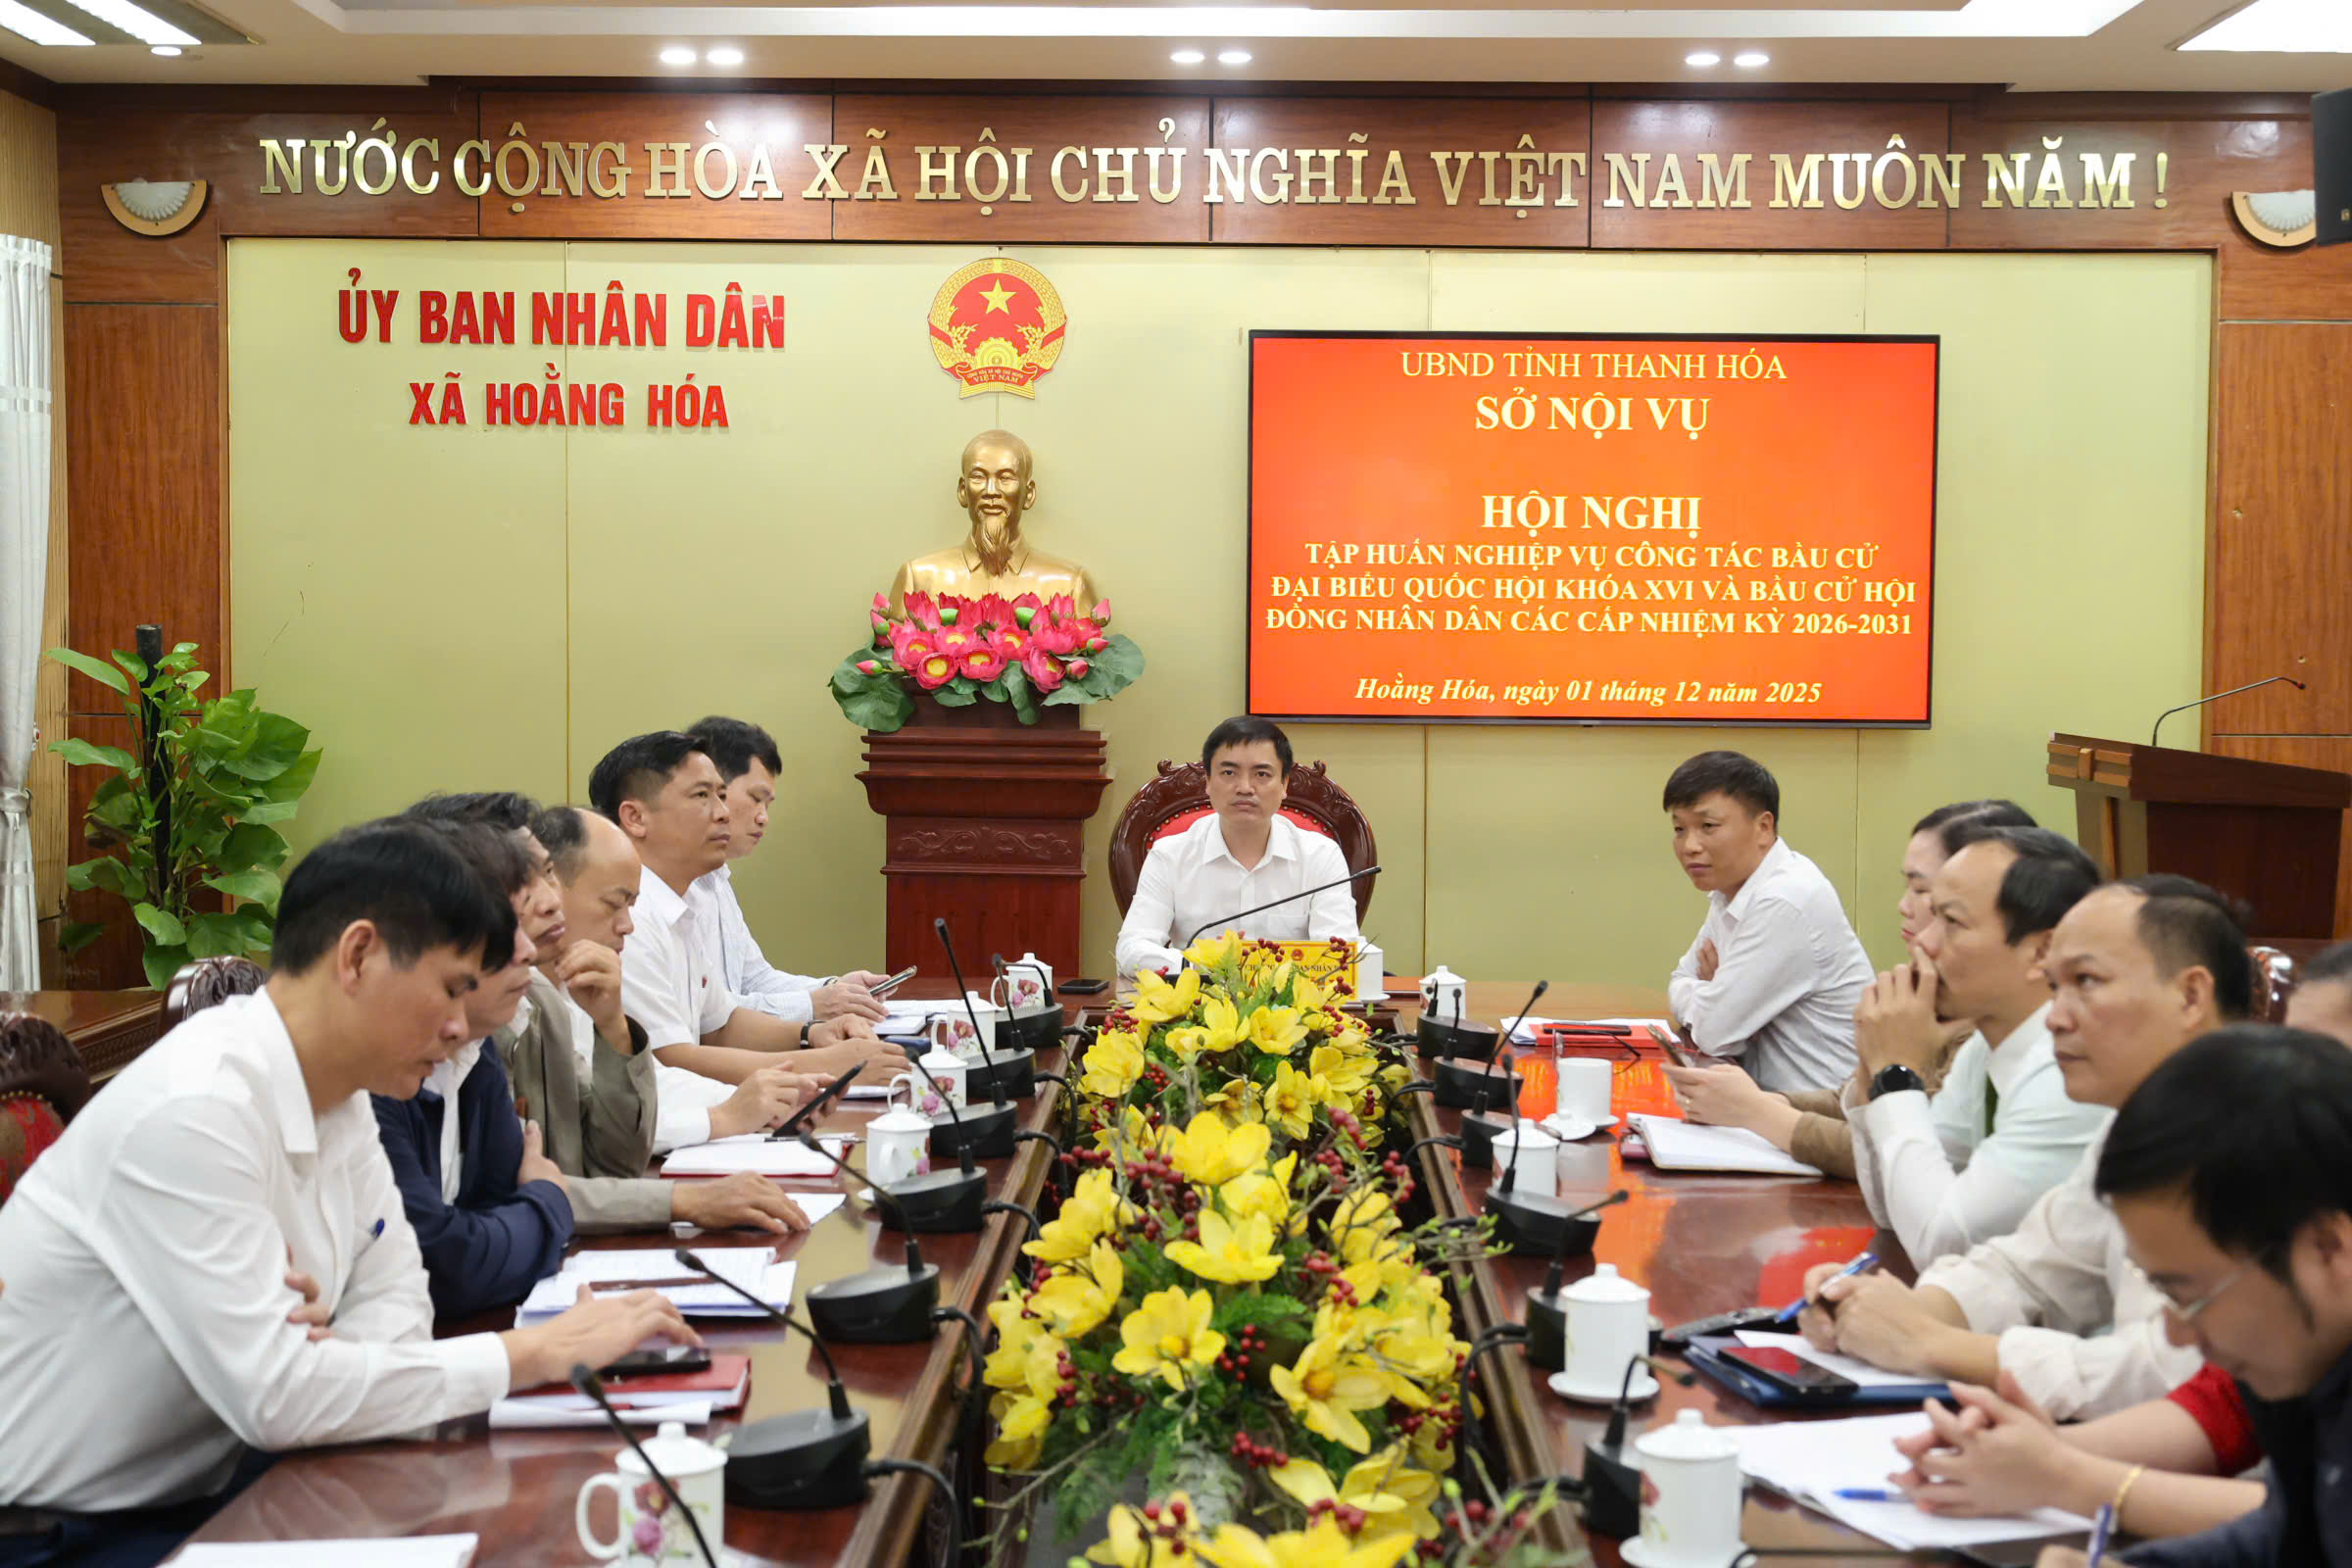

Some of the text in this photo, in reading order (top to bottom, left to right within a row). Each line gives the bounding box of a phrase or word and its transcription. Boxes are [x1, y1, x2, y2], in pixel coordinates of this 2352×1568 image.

[260, 118, 439, 195] NƯỚC
[454, 122, 632, 213] CỘNG
[644, 120, 784, 199] HÒA
[802, 127, 898, 199] XÃ
[914, 127, 1033, 216] HỘI
[1051, 118, 1187, 203] CHỦ
[1203, 132, 1416, 204] NGHĨA
[1431, 134, 1587, 219] VIỆT
[1603, 153, 1752, 209] NAM
[1769, 133, 1966, 210] MUÔN
[1982, 136, 2136, 209] NĂM
[338, 268, 785, 348] ỦY BAN NHÂN DÂN
[1401, 346, 1787, 379] UBND TỈNH THANH HÓA
[410, 363, 728, 426] XÃ HOẰNG HÓA
[1475, 386, 1710, 440] SỞ NỘI VỤ
[1481, 490, 1701, 540] HỘI NGHỊ
[1305, 538, 1880, 571] TẬP HUẤN NGHIỆP VỤ CÔNG TÁC BẦU CỬ
[1271, 571, 1916, 608] ĐẠI BIỂU QUỐC HỘI KHÓA XVI VÀ BẦU CỬ HỘI
[1266, 603, 1913, 638] ĐỒNG NHÂN DÂN CÁC CẤP NHIỆM KỲ 2026-2031
[1354, 672, 1822, 707] Hoằng Hóa, ngày 01 tháng 12 năm 2025
